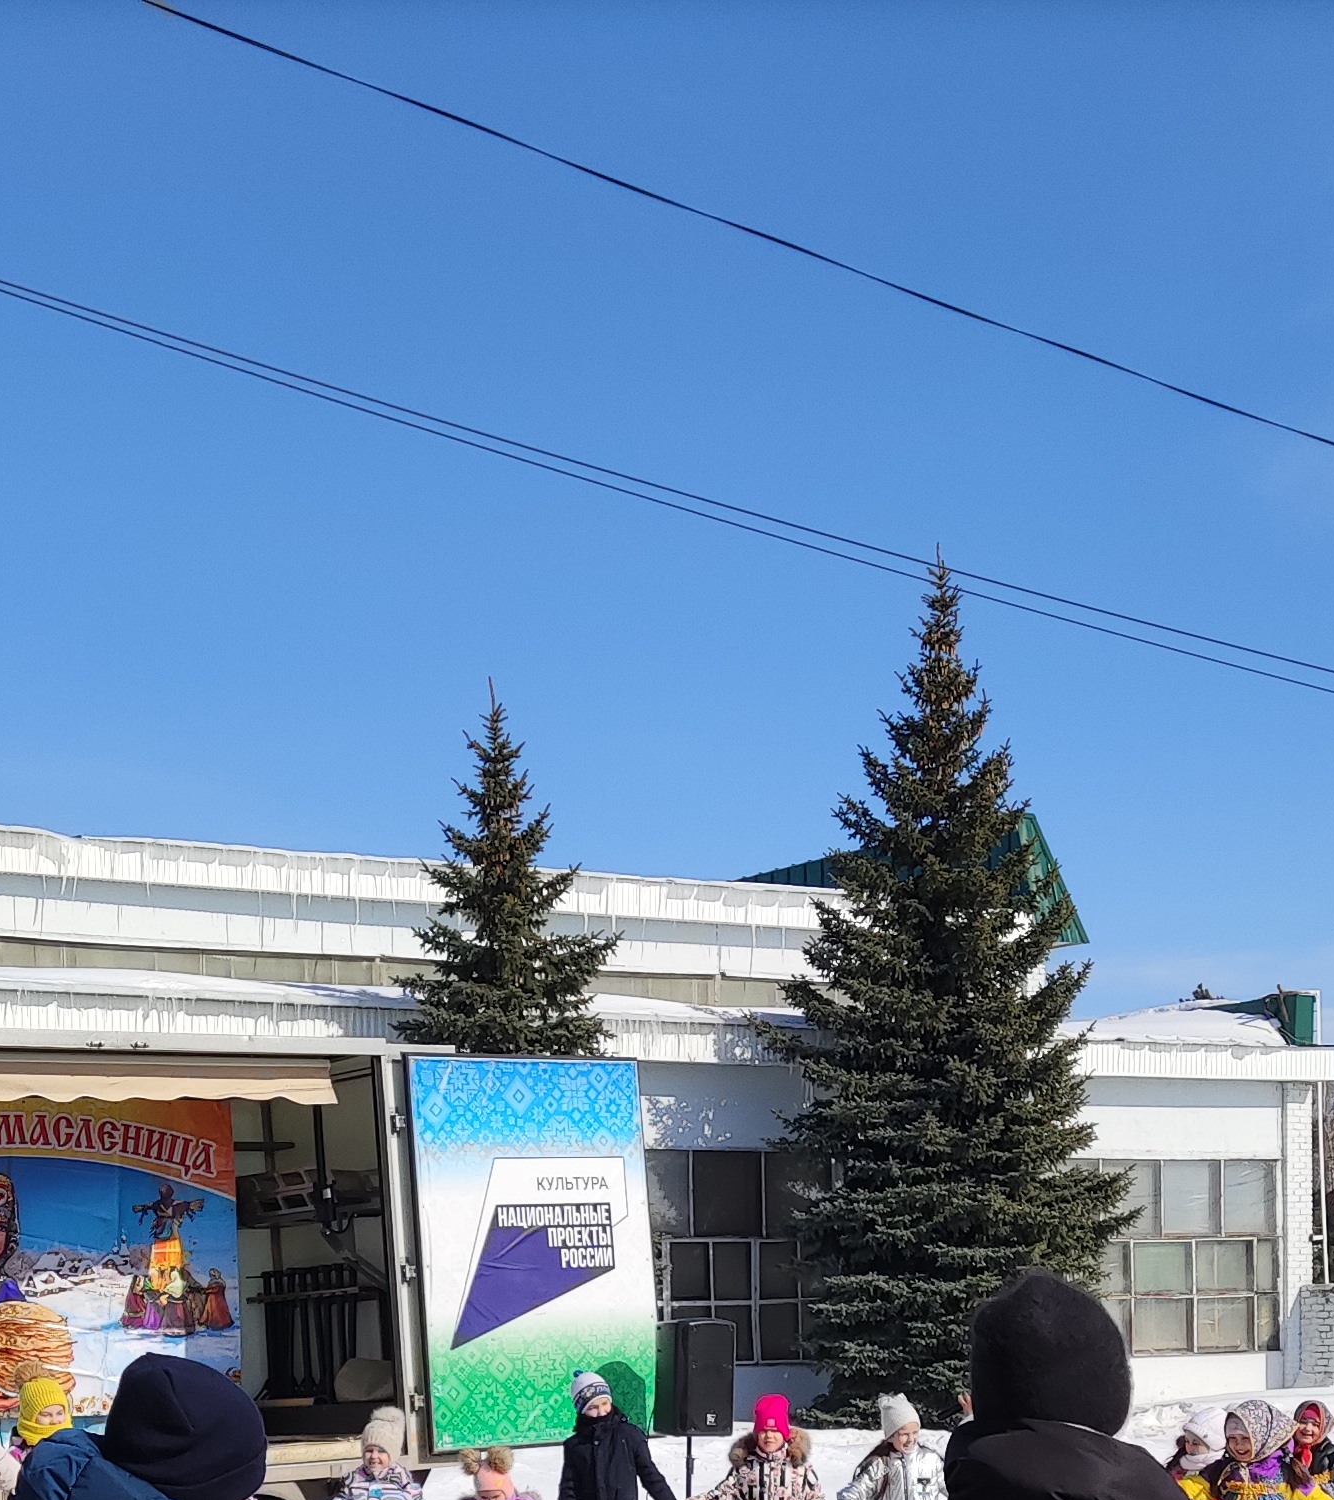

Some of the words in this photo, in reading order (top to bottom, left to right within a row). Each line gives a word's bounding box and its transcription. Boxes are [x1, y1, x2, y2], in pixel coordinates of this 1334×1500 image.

[536, 1176, 610, 1191] КУЛЬТУРА
[497, 1205, 611, 1229] НАЦИОНАЛЬНЫЕ
[547, 1226, 612, 1247] ПРОЕКТЫ
[560, 1246, 614, 1269] РОССИИ
